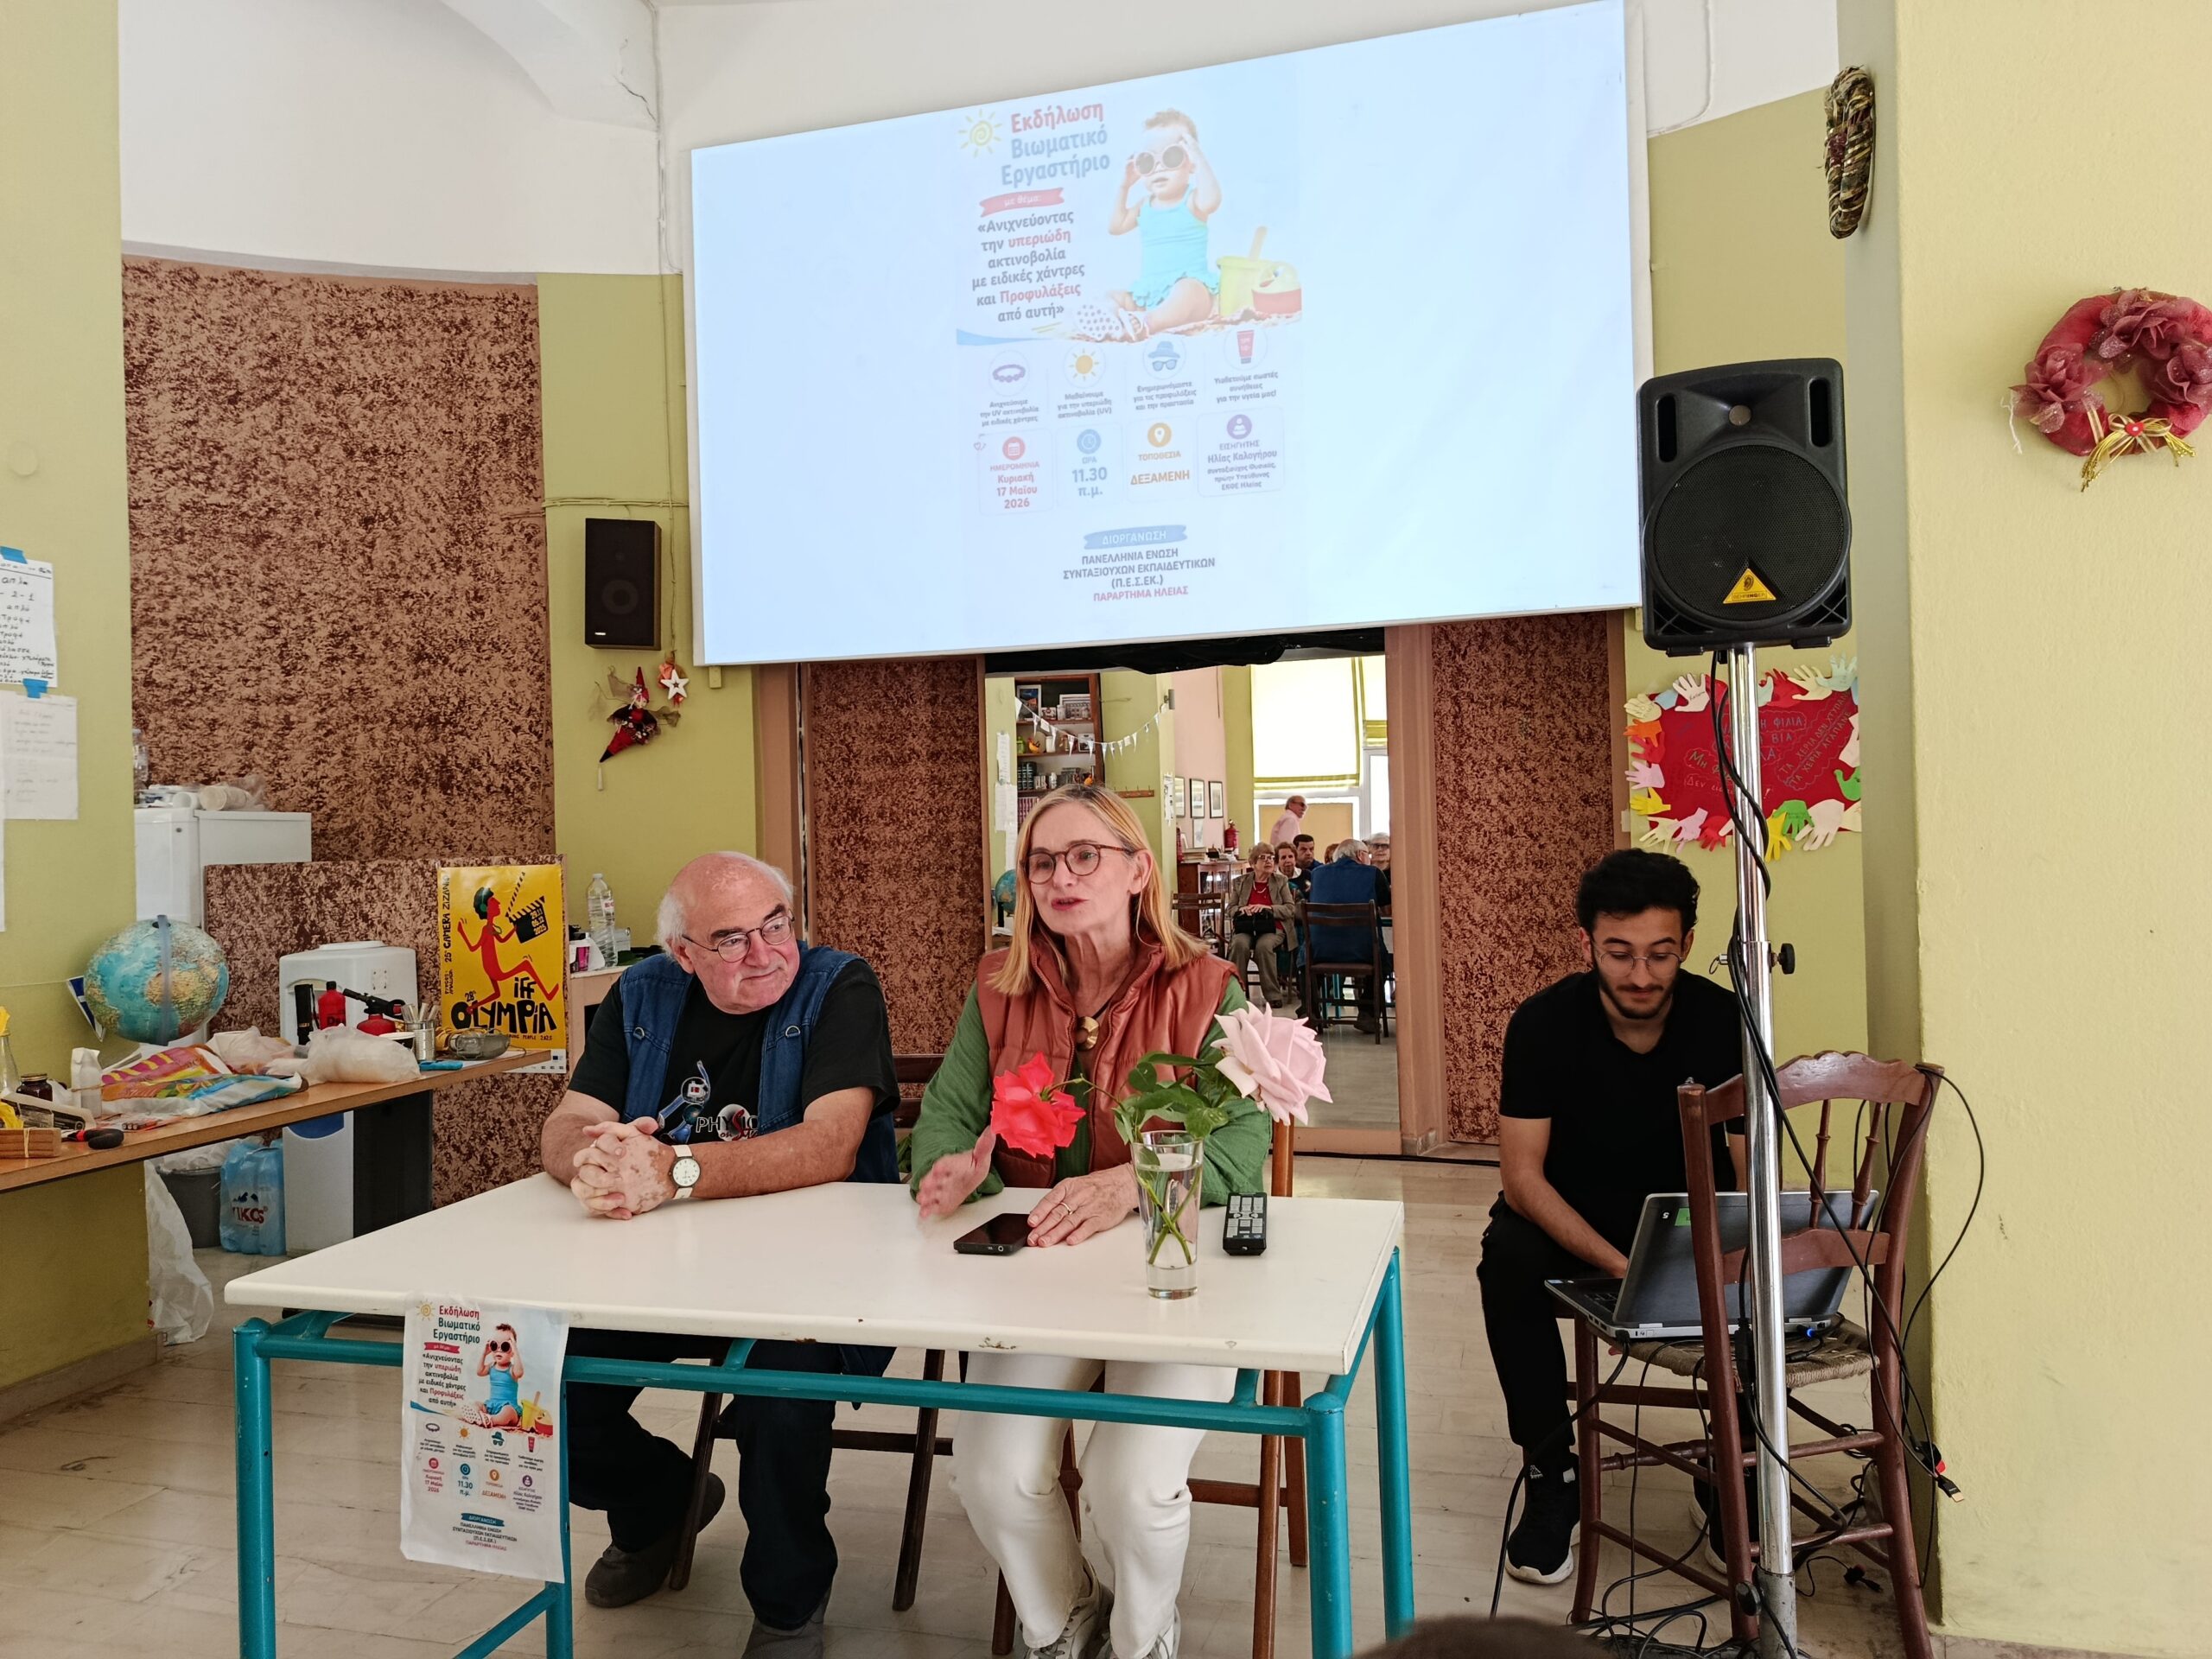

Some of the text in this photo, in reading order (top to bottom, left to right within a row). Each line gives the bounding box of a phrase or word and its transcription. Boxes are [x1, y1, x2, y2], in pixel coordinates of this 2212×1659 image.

[1011, 103, 1103, 133] Εκδήλωση
[1011, 124, 1108, 159] Βιωματικό
[1001, 154, 1110, 188] Εργαστήριο
[977, 212, 1074, 232] «Ανιχνεύοντας
[981, 228, 1071, 252] την υπεριώδη
[988, 248, 1066, 268] ακτινοβολία
[972, 264, 1085, 290] με ειδικές χάντρες
[976, 283, 1081, 306] και Προφυλάξεις
[997, 302, 1065, 321] από αυτή»
[1208, 449, 1278, 467] Ηλίας Καλογήρου
[997, 472, 1035, 485] Κυριακή
[1071, 467, 1108, 483] 11.30
[1130, 470, 1190, 486] ΔΕΞΑΜΕΝΗ
[996, 488, 1007, 498] 17
[1077, 487, 1103, 499] π.μ.
[1004, 498, 1031, 510] 2026
[1102, 531, 1167, 546] ΔΙΟΡΓΑΝΩΣΗ
[1081, 549, 1179, 566] ΠΑΝΕΛΛΗΝΙΑ ΕΝΩΣΗ
[1063, 557, 1216, 580] ΣΥΝΤΑΞΙΟΥΧΩΝ ΕΚΠΑΙΔΕΥΤΙΚΩΝ
[1111, 575, 1164, 589] (Π.Ε.Σ.ΕΚ.)
[1093, 586, 1189, 602] ΠΑΡΑΡΤΗΜΑ ΗΛΕΙΑΣ
[442, 913, 451, 949] CAMERA
[440, 1306, 480, 1320] Εκδήλωση
[439, 1317, 480, 1332] Βιωματικό
[433, 1329, 480, 1344] Εργαστήριο
[423, 1353, 464, 1364] «Ανιχνεύοντας
[425, 1371, 459, 1382] ακτινοβολία
[435, 1363, 461, 1374] υπεριώδη
[426, 1379, 444, 1389] ειδικές
[445, 1382, 467, 1392] χάντρες
[429, 1388, 464, 1401] Προφυλάξεις
[458, 1480, 474, 1490] 11.30
